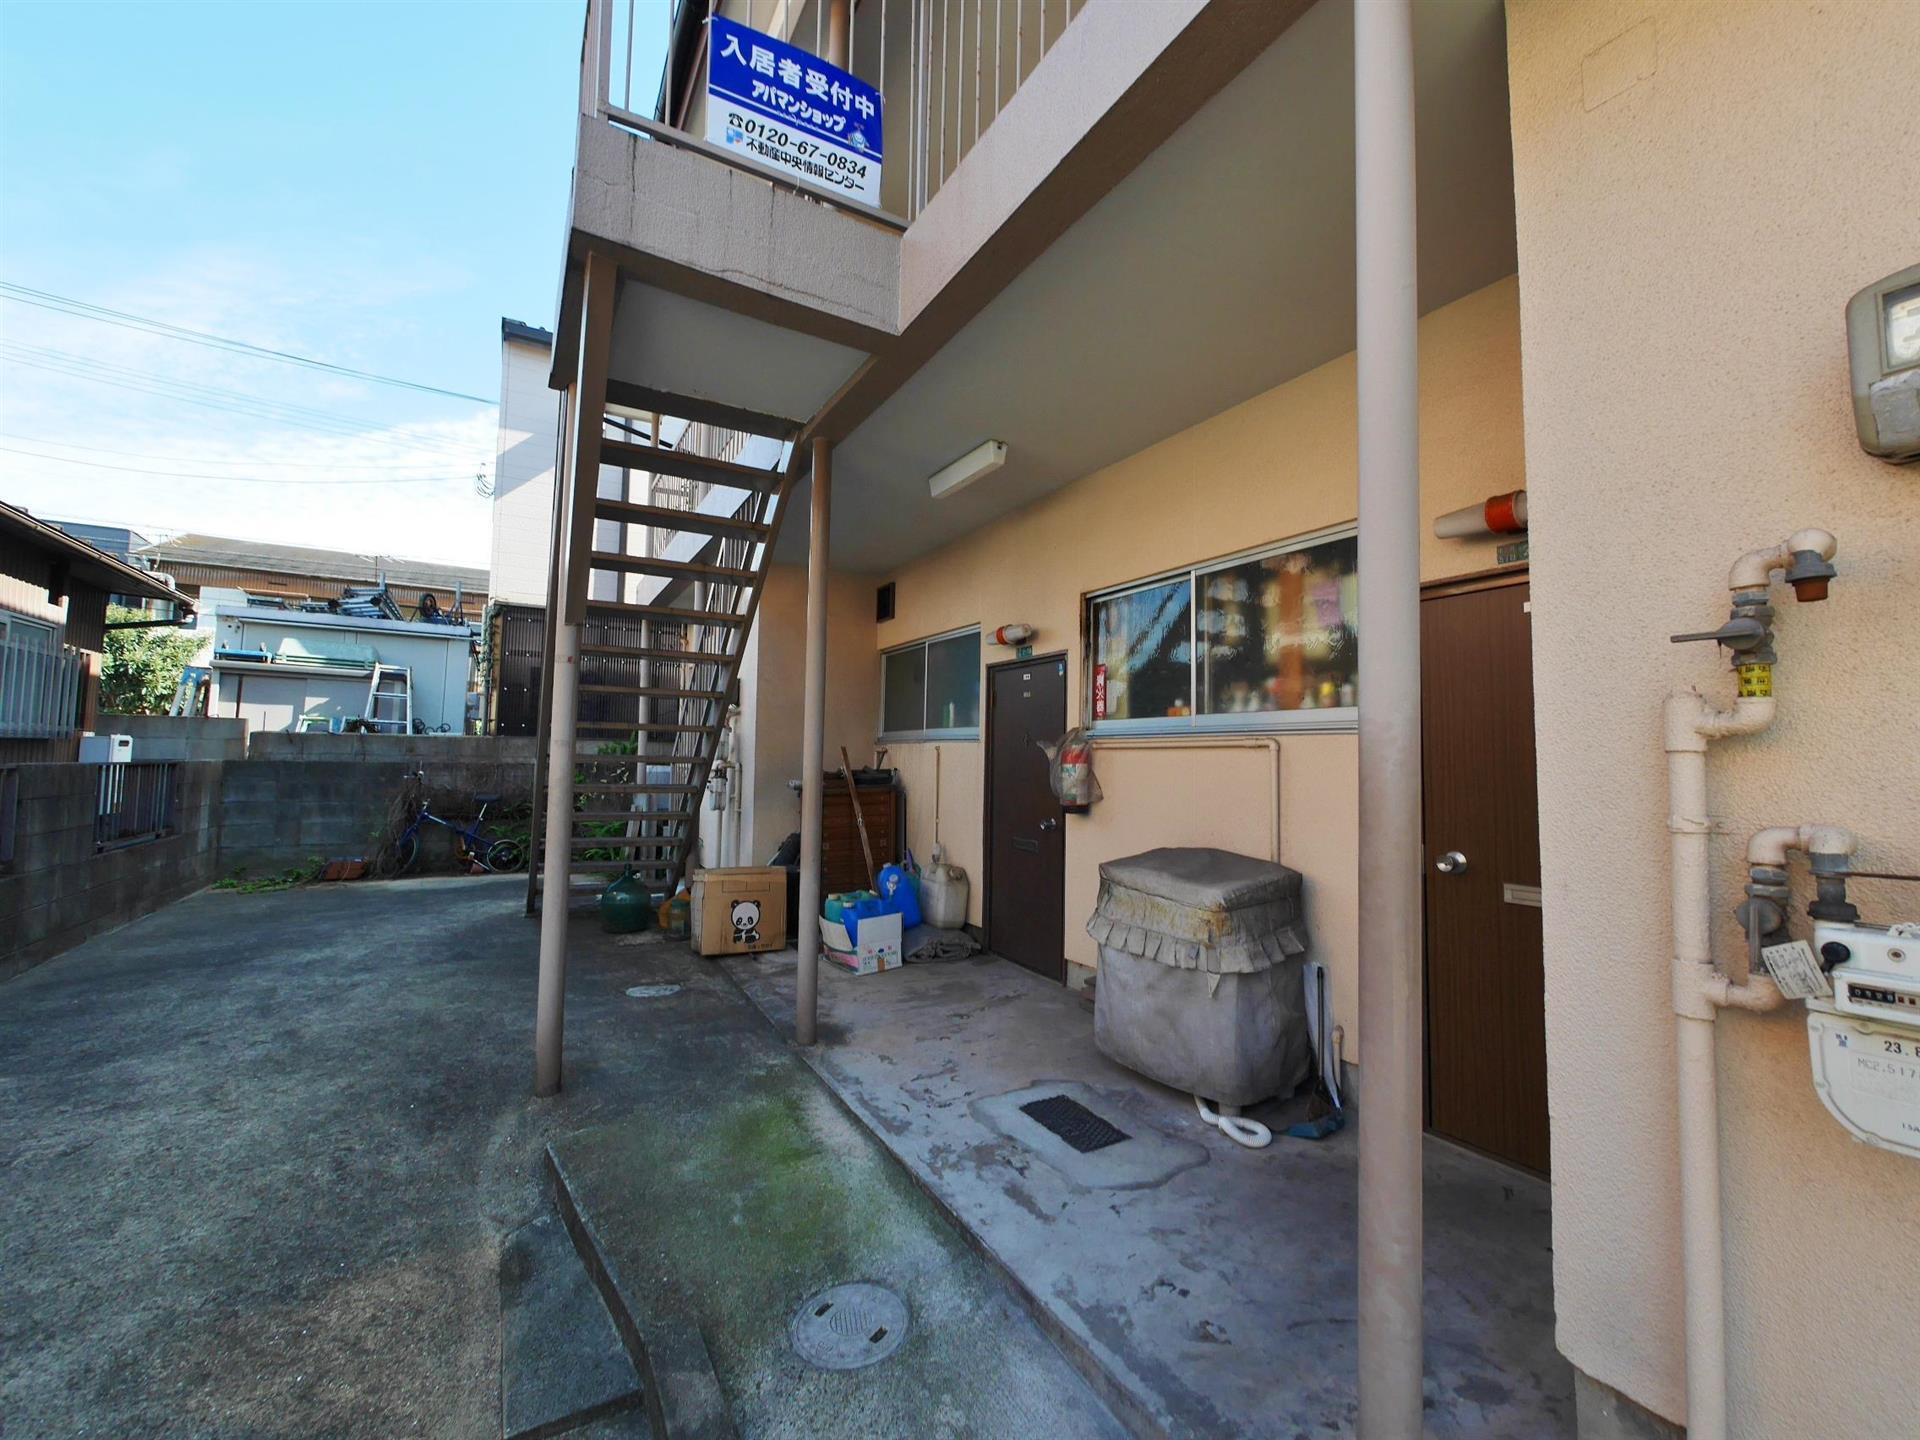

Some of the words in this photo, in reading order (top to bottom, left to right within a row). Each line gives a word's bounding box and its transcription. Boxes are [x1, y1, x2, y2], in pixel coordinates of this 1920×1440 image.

[720, 33, 875, 120] 入居者受付中
[751, 79, 847, 132] アパマンショップ
[744, 119, 867, 179] 0120-67-0834
[746, 135, 866, 191] 不動産中央情報センター
